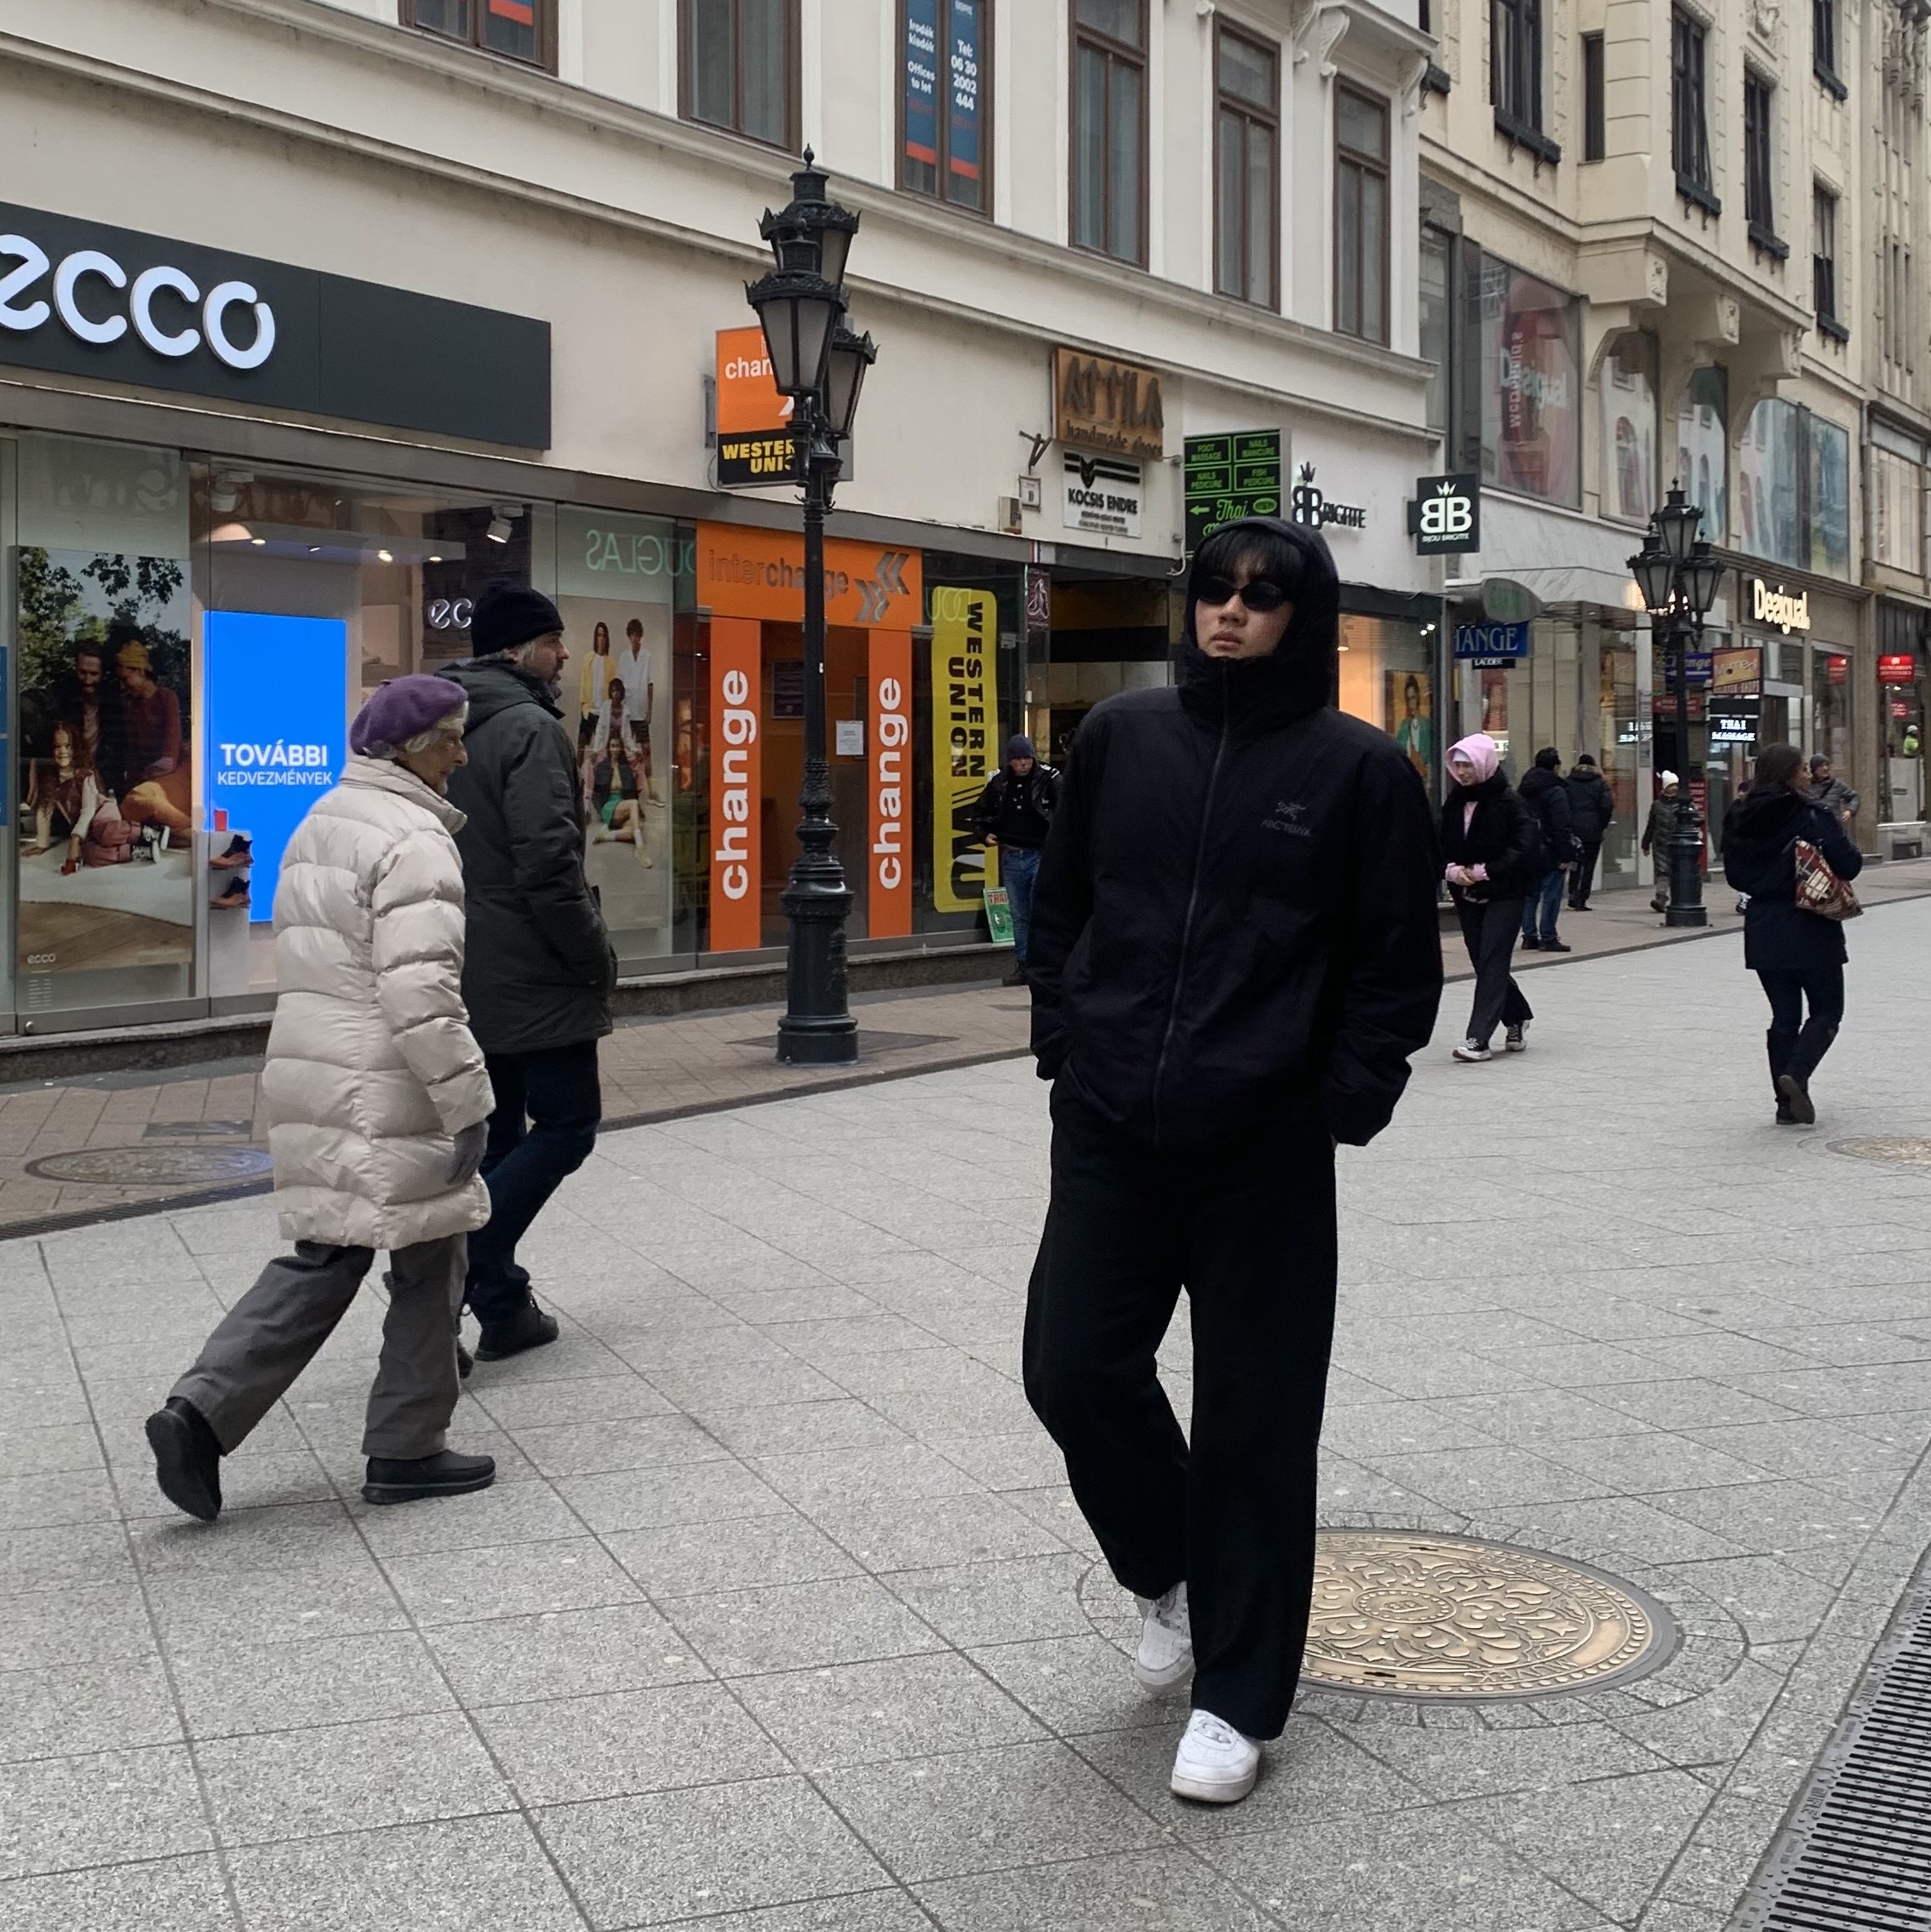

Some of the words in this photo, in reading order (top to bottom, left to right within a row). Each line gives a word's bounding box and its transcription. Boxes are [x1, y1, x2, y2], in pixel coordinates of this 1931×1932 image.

[908, 60, 936, 82] Offices
[953, 73, 977, 95] 2002
[955, 92, 975, 111] 444
[0, 234, 276, 369] ecco
[725, 357, 774, 380] chan
[722, 439, 795, 460] WESTER
[1068, 488, 1104, 508] KOCSIS
[1106, 495, 1137, 515] ENDRE
[1216, 498, 1248, 521] Thai
[708, 549, 849, 602] interchage
[1455, 627, 1518, 652] ANGE
[967, 601, 986, 778] WESTERN
[948, 656, 968, 778] UNION
[1720, 719, 1746, 731] THAI
[221, 738, 328, 767] TOVÁBBI
[217, 769, 333, 786] KEDVEZMÉNYEK
[715, 669, 757, 900] change
[874, 677, 908, 889] change
[27, 954, 56, 964] ecco
